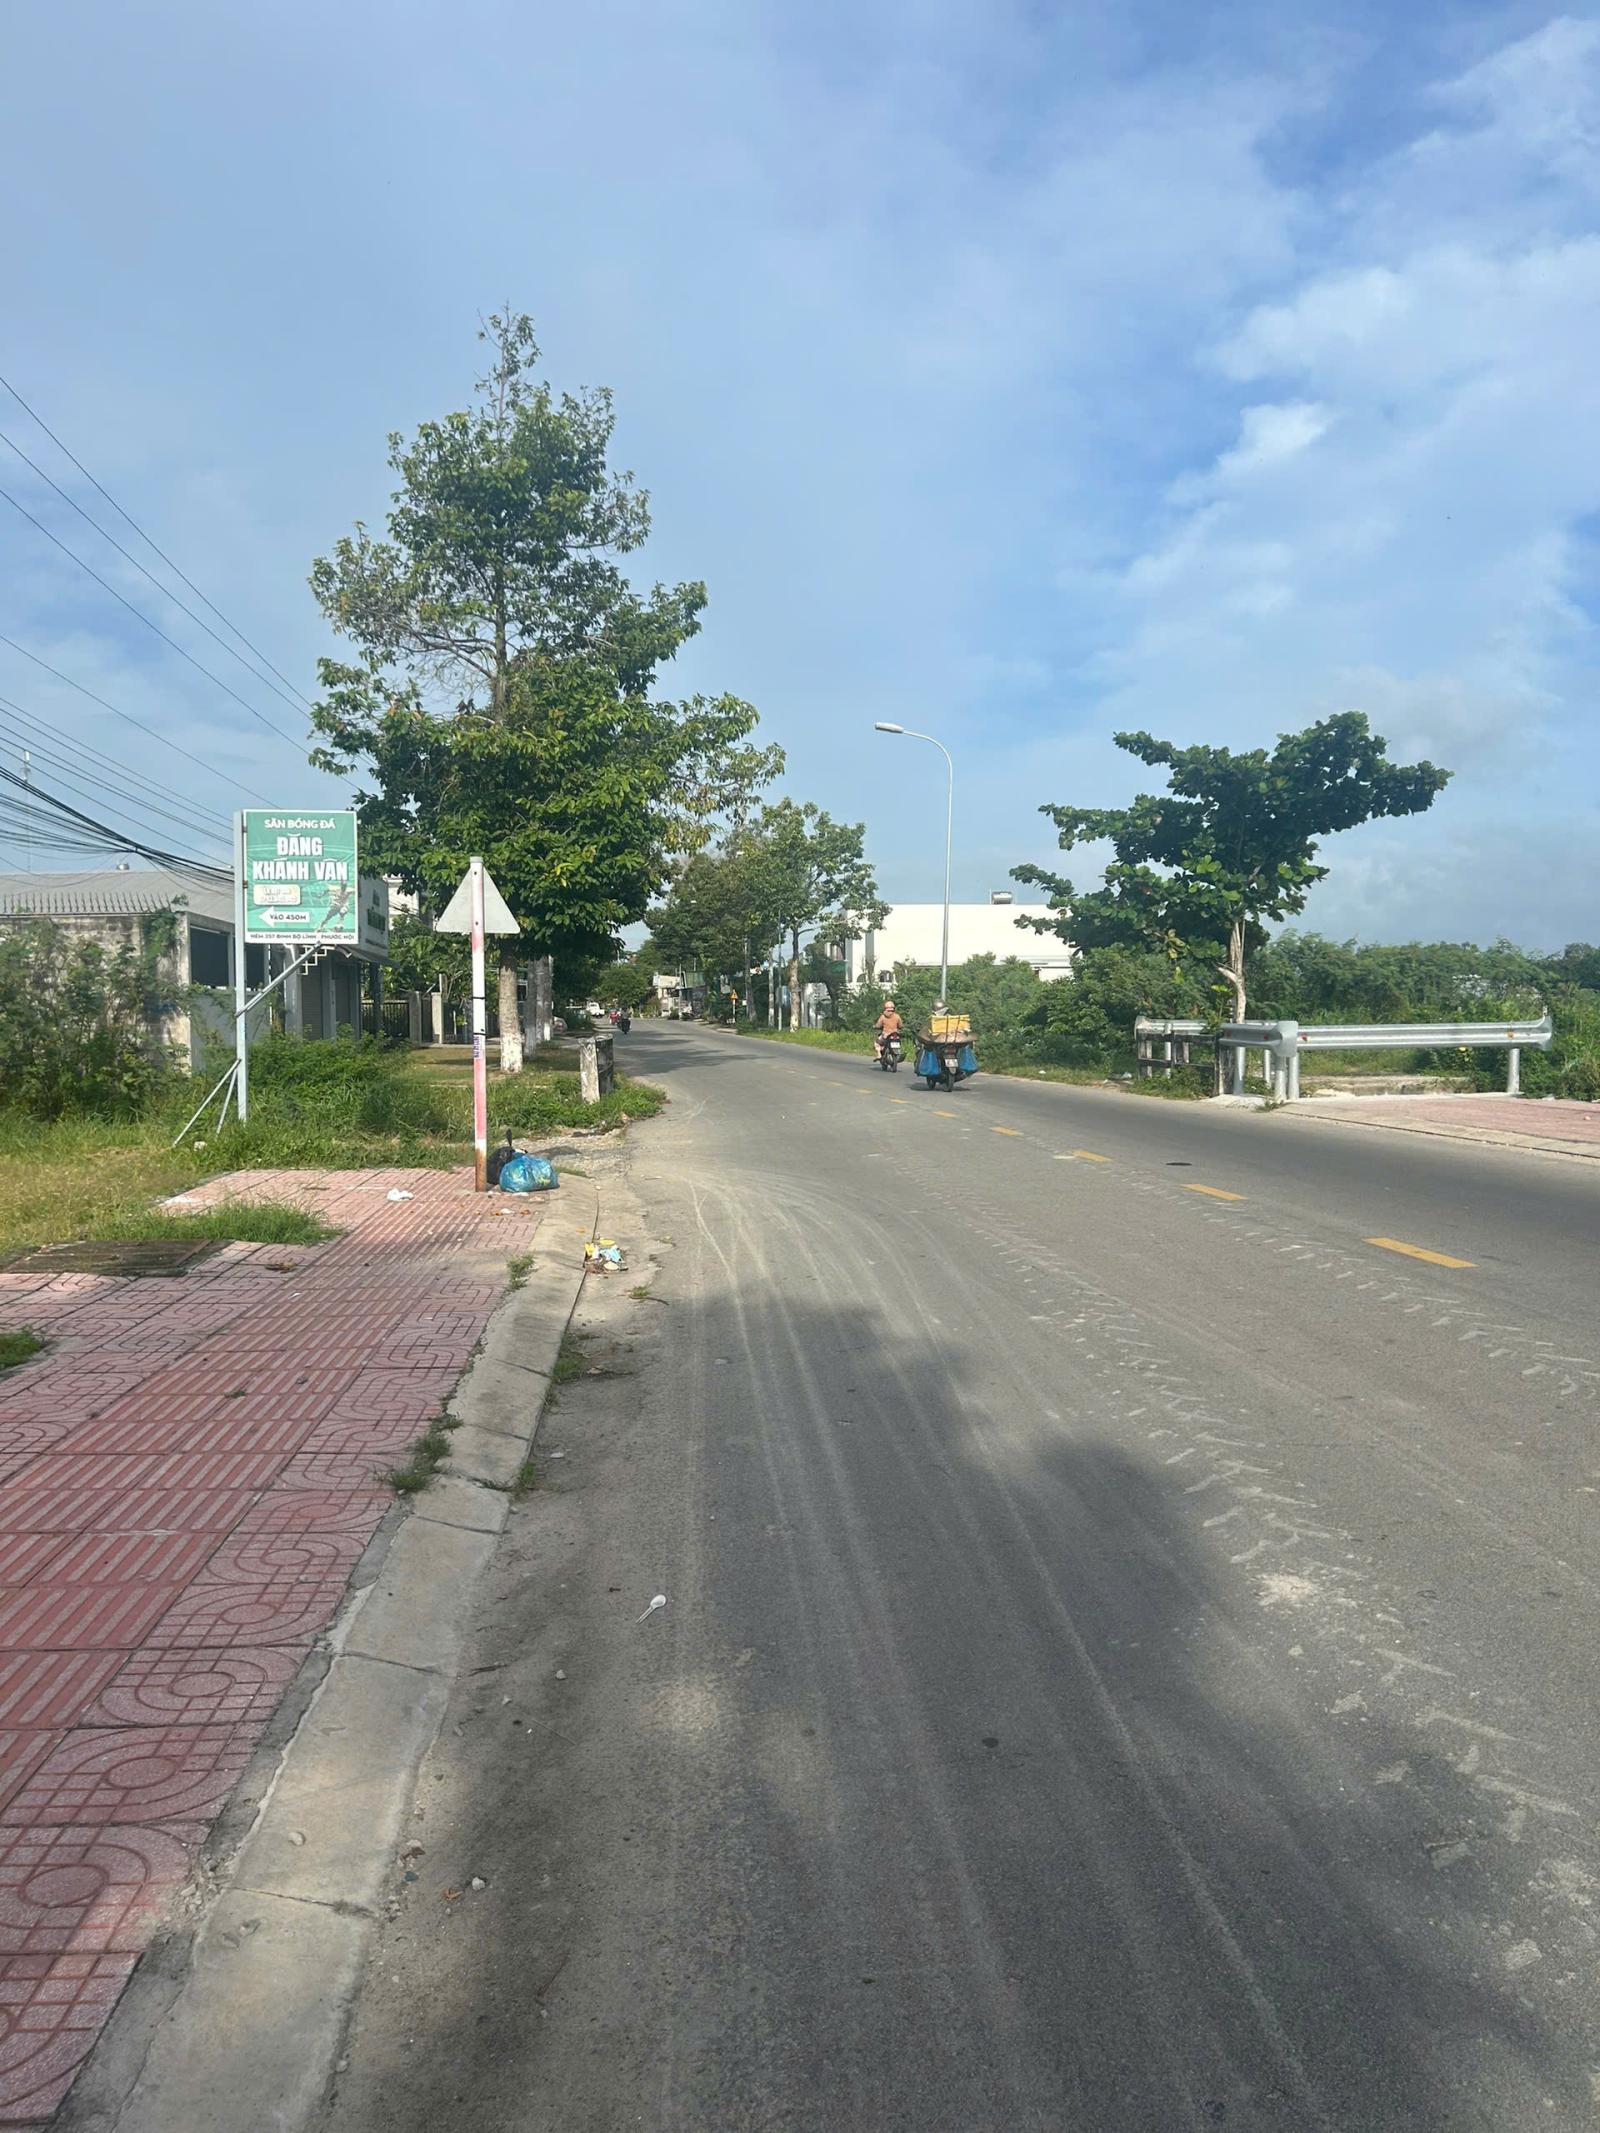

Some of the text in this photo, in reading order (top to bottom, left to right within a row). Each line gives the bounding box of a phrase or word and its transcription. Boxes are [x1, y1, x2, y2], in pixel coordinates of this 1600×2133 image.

[287, 817, 319, 829] BÓNG
[319, 817, 336, 829] ĐÁ
[277, 833, 323, 856] ĐĂNG
[253, 857, 348, 881] KHÁNH VÂN
